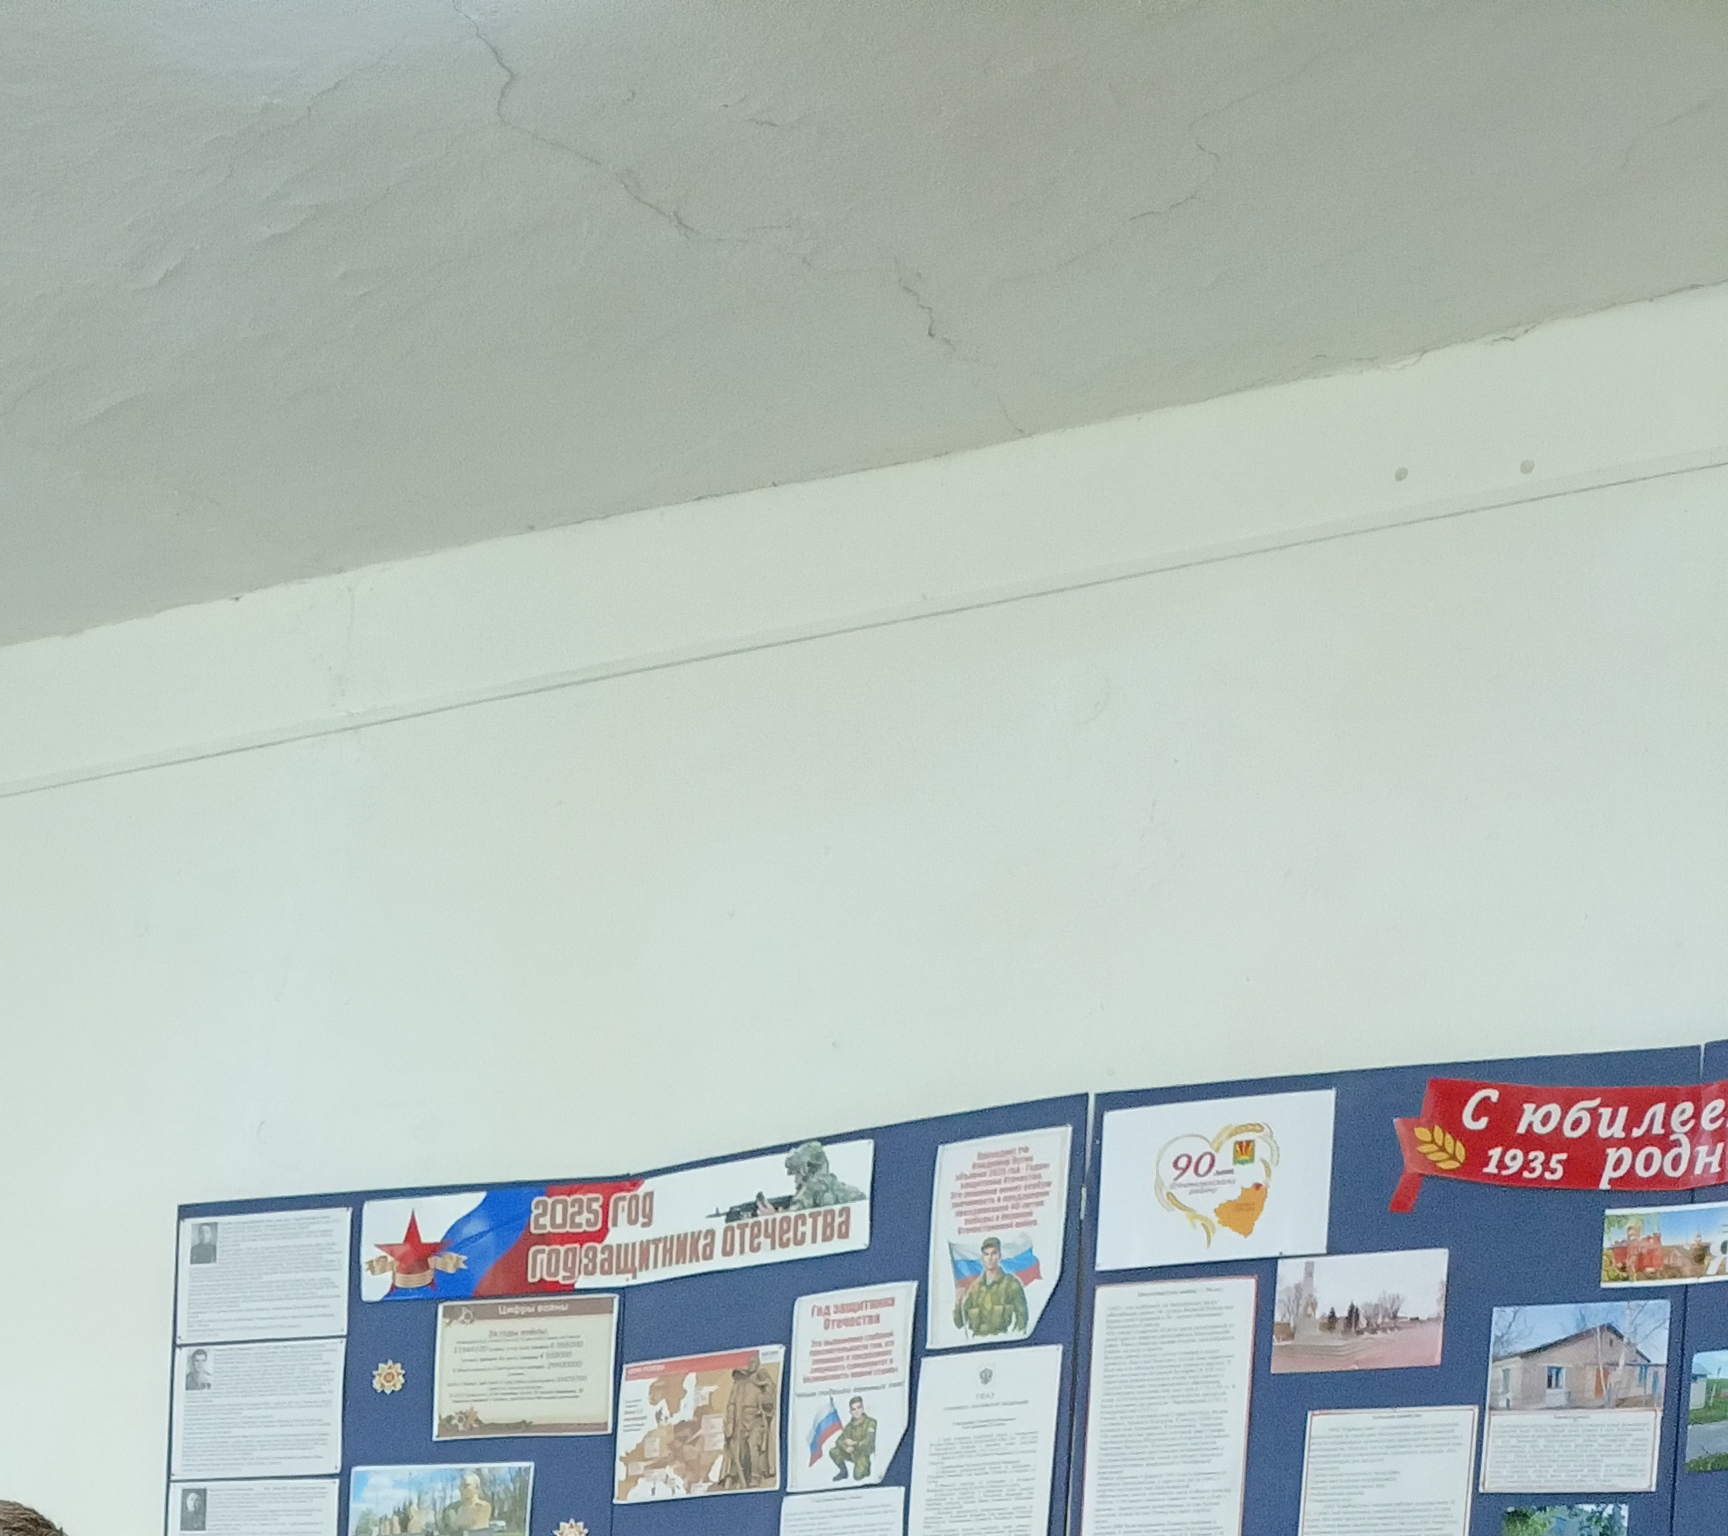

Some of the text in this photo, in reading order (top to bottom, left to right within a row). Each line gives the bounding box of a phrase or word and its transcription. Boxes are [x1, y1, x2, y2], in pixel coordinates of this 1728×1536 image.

[1462, 1088, 1728, 1139] С юбилее
[1172, 1151, 1216, 1181] 90
[1482, 1132, 1728, 1190] 1935 родн
[530, 1196, 602, 1233] 2025
